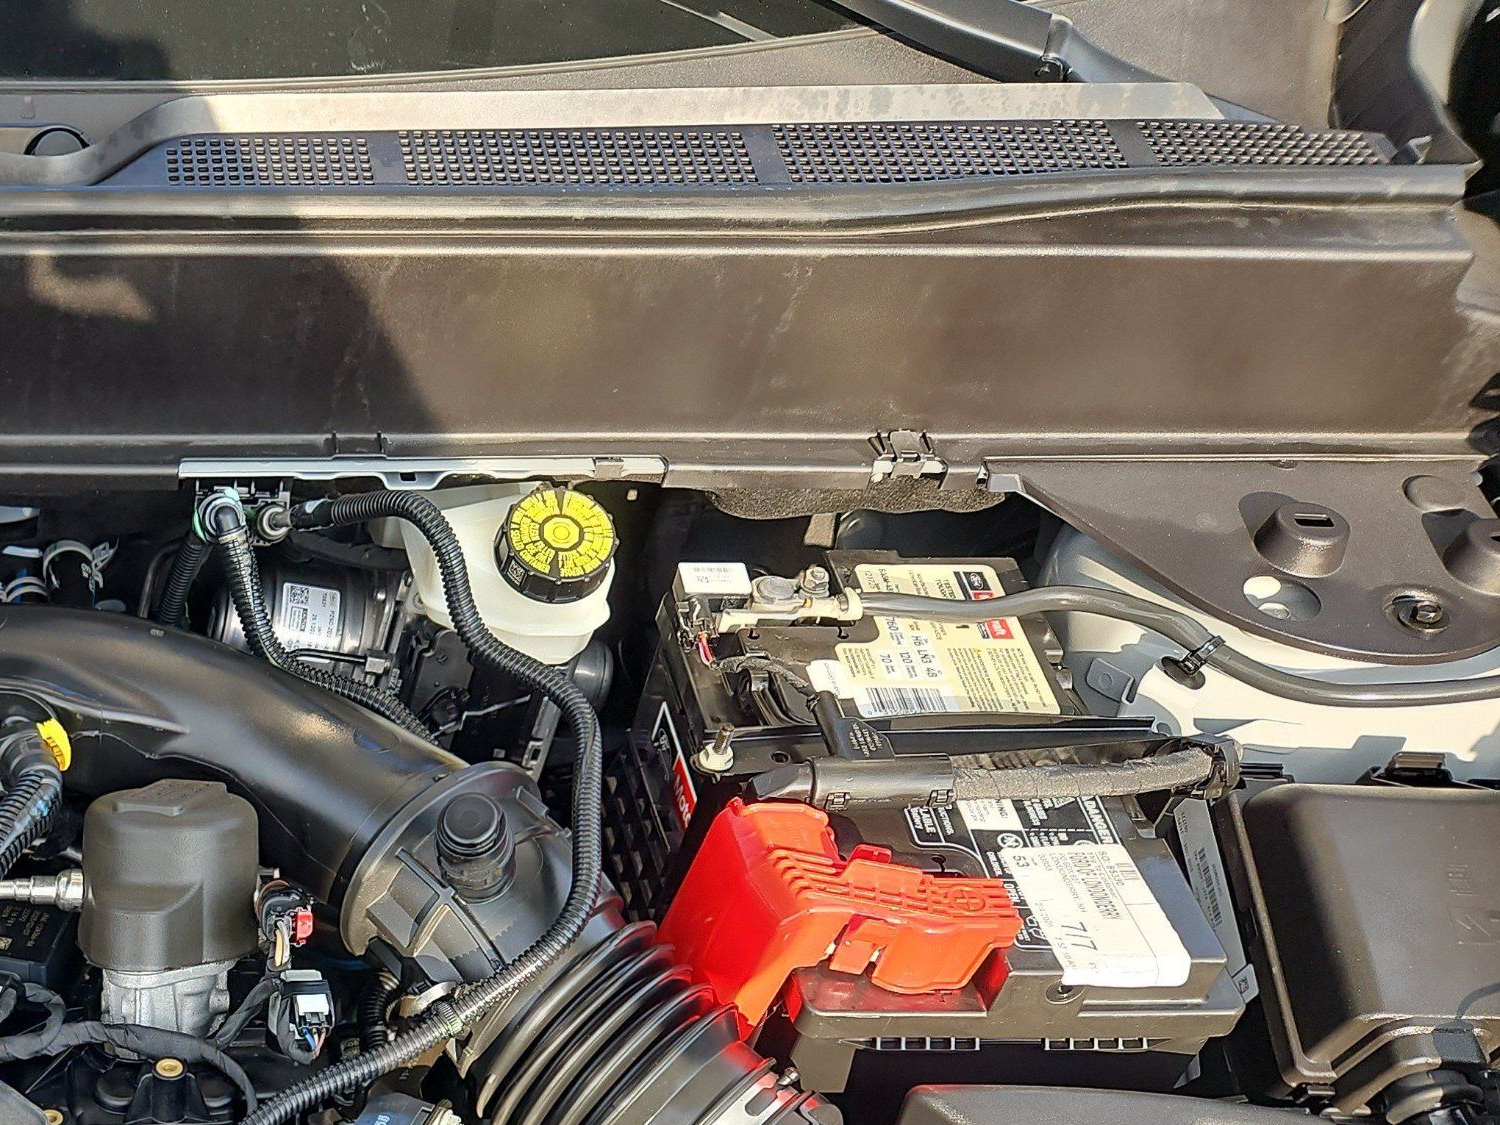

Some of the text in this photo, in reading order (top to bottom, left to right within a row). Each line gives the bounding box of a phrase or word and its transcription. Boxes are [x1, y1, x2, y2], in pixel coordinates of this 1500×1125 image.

[884, 616, 899, 631] 760
[879, 653, 892, 664] 70
[898, 650, 913, 663] 120
[917, 649, 932, 664] LN3
[1082, 799, 1114, 845] DANGER
[1012, 854, 1030, 868] 53
[1060, 921, 1098, 950] 7/7
